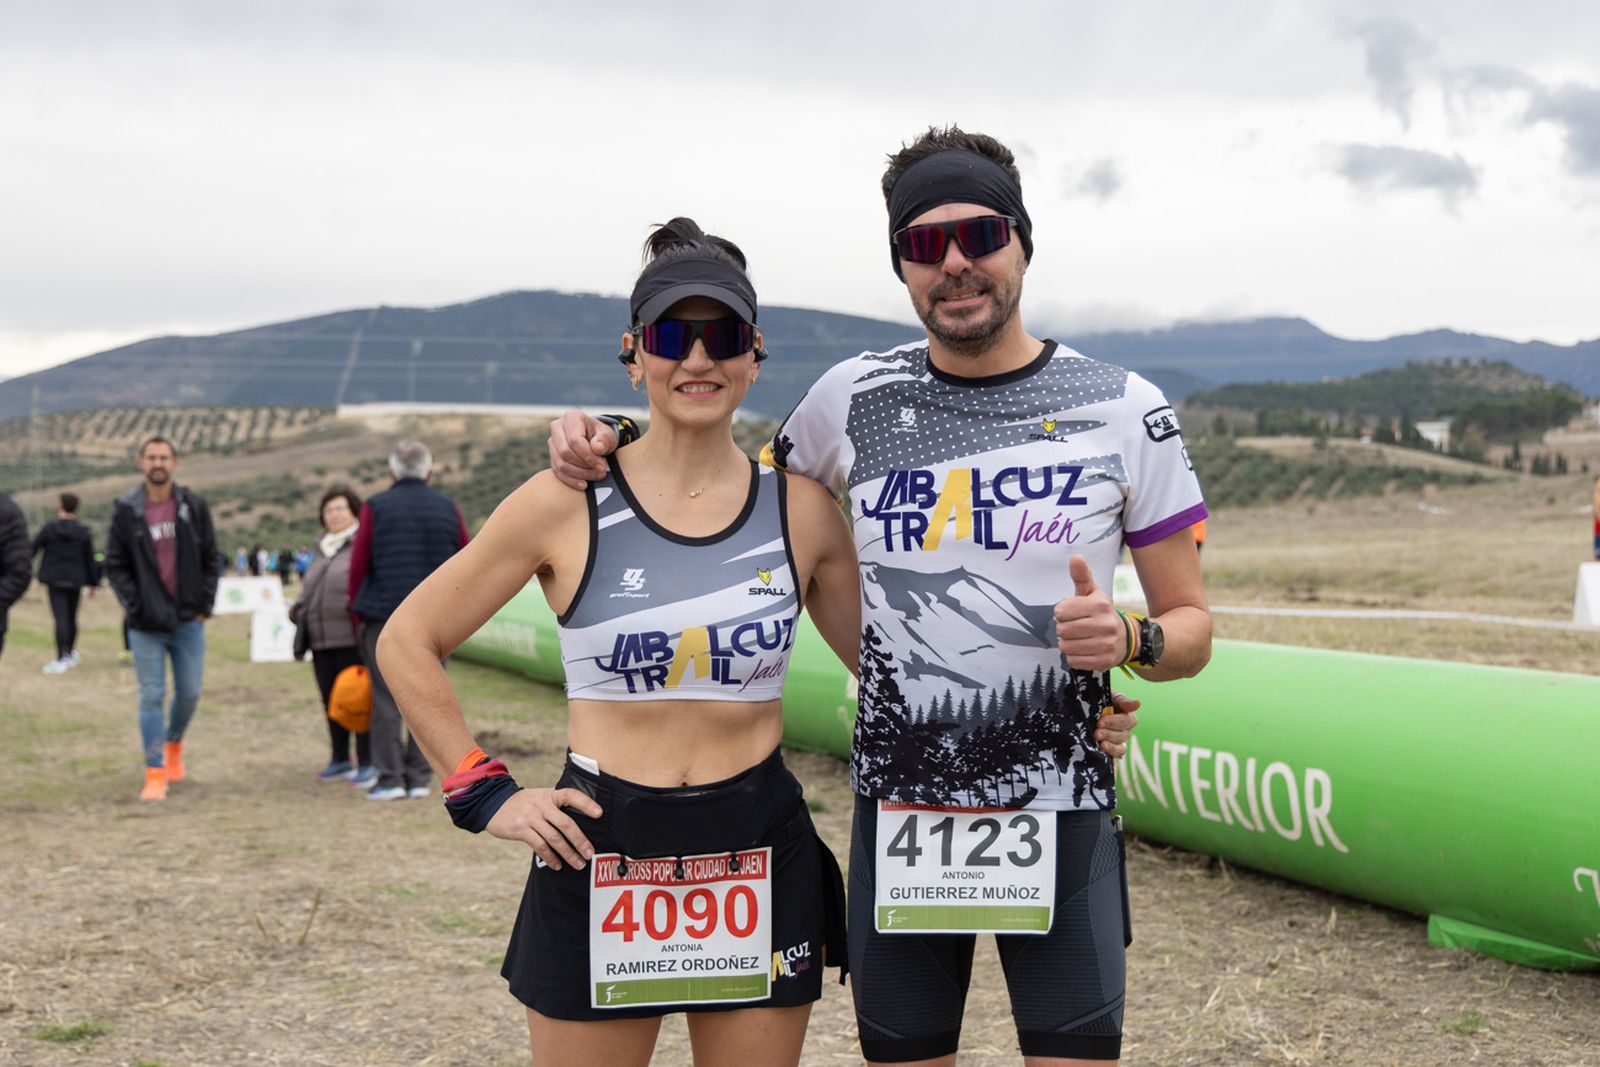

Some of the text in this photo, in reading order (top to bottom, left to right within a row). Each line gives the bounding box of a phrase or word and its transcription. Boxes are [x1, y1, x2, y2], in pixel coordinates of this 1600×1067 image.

[1028, 433, 1069, 443] SPALL
[861, 465, 1087, 519] JABALCUZ
[877, 500, 1081, 561] TRAIL Jaén
[748, 588, 786, 597] SPALL
[614, 648, 742, 694] TRAIL
[886, 814, 1042, 868] 4123
[653, 861, 693, 882] POPUAR
[694, 859, 725, 881] CIUDAD
[740, 854, 763, 876] JAEN
[942, 871, 985, 880] ANTONIO
[890, 884, 1040, 900] GUTIERREZ MUÑOZ
[602, 885, 759, 942] 4090
[661, 943, 703, 953] ANTONIA
[606, 953, 760, 976] RAMIREZ ORDOÑEZ
